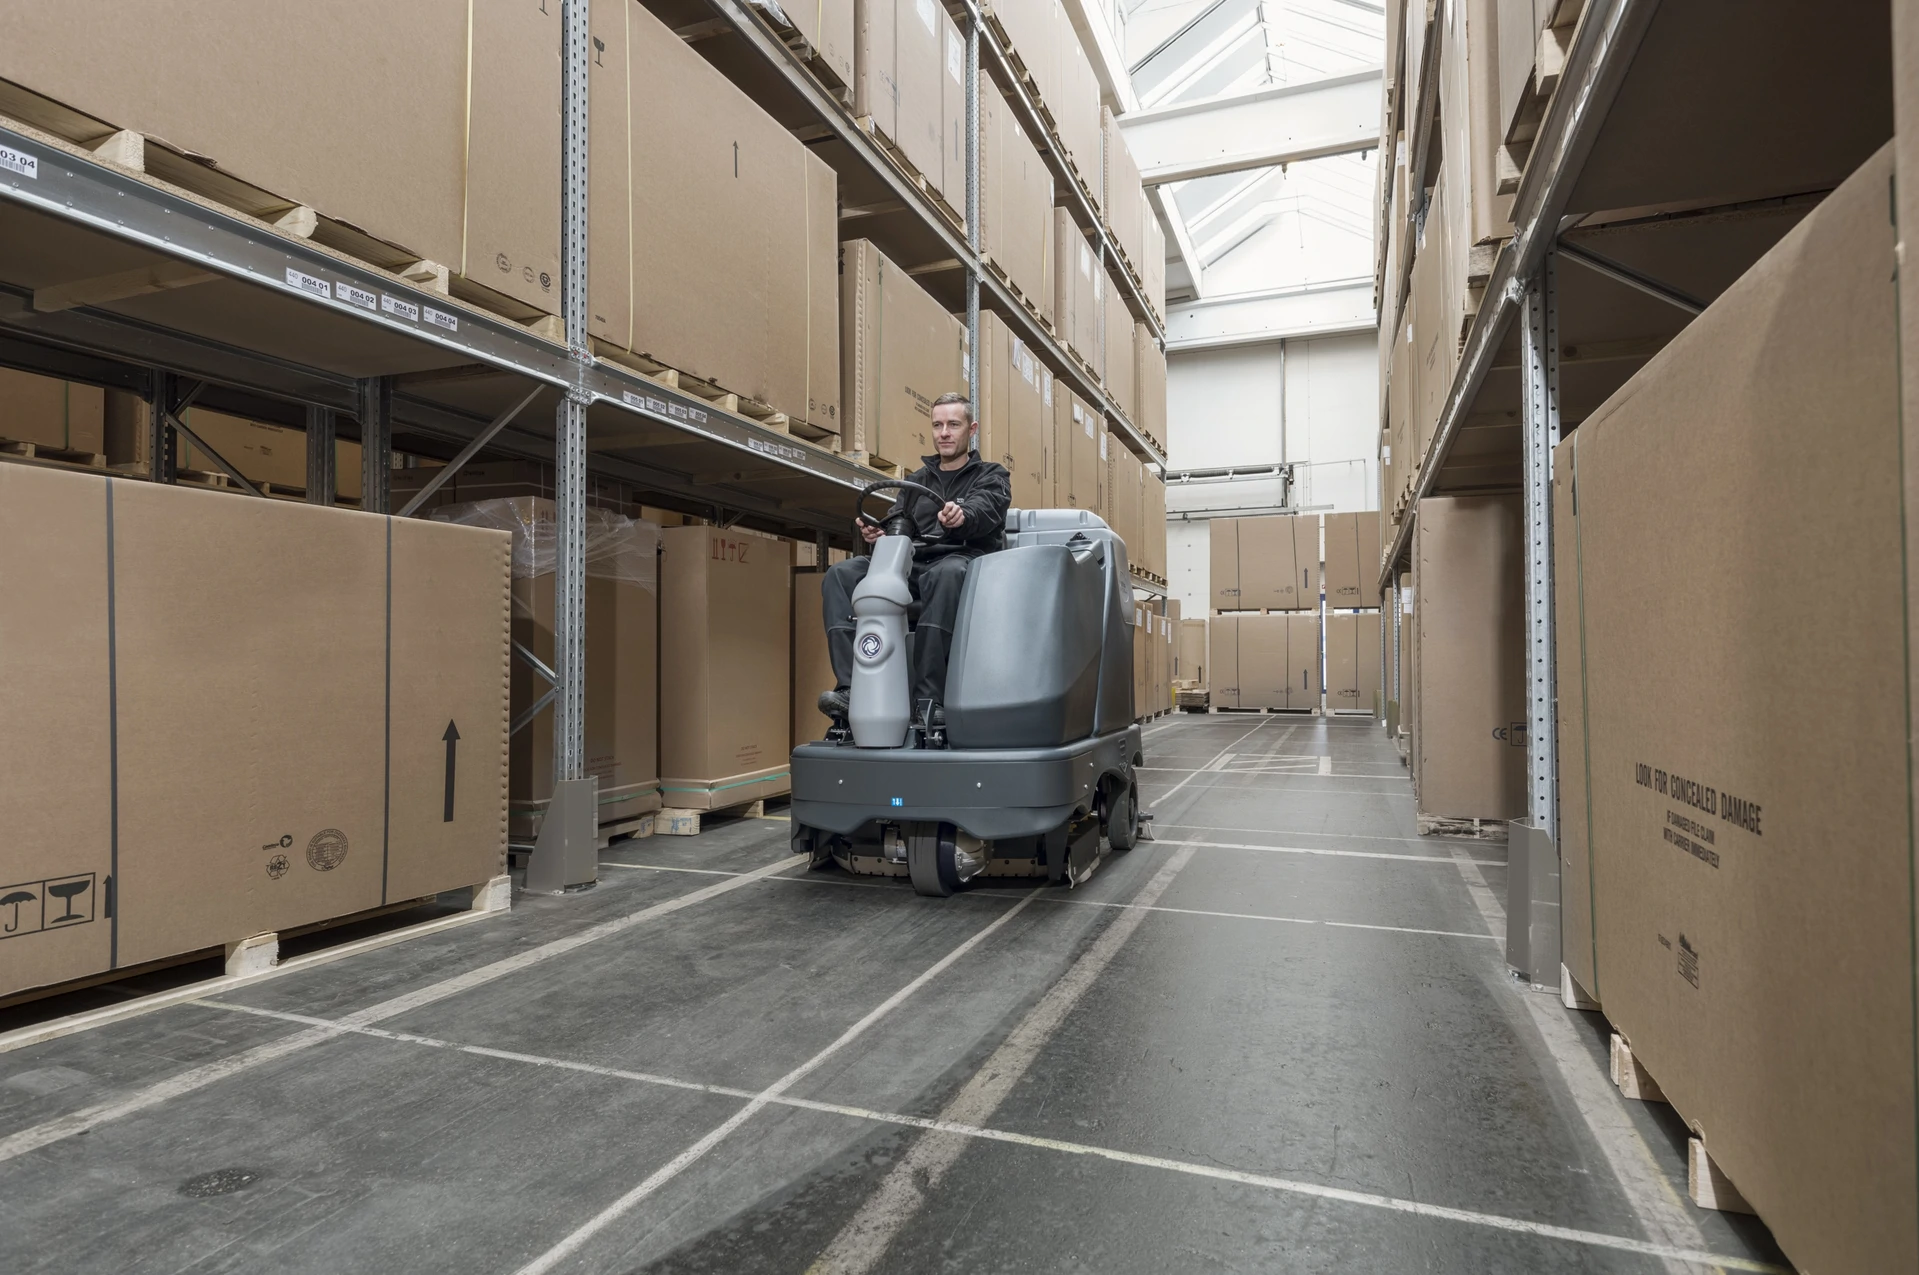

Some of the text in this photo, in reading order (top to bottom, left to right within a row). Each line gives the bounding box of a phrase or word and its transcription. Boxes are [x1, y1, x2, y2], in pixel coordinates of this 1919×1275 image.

[20, 157, 35, 169] 04
[301, 276, 317, 287] 004
[318, 282, 328, 291] 01
[350, 289, 364, 300] 004
[365, 295, 375, 304] 02
[394, 302, 407, 312] 004
[408, 307, 417, 315] 03
[435, 313, 447, 322] 004
[447, 317, 456, 325] 04
[1492, 727, 1507, 740] CE
[1635, 762, 1762, 836] LOOK FOR CONCEALED DAMAGE
